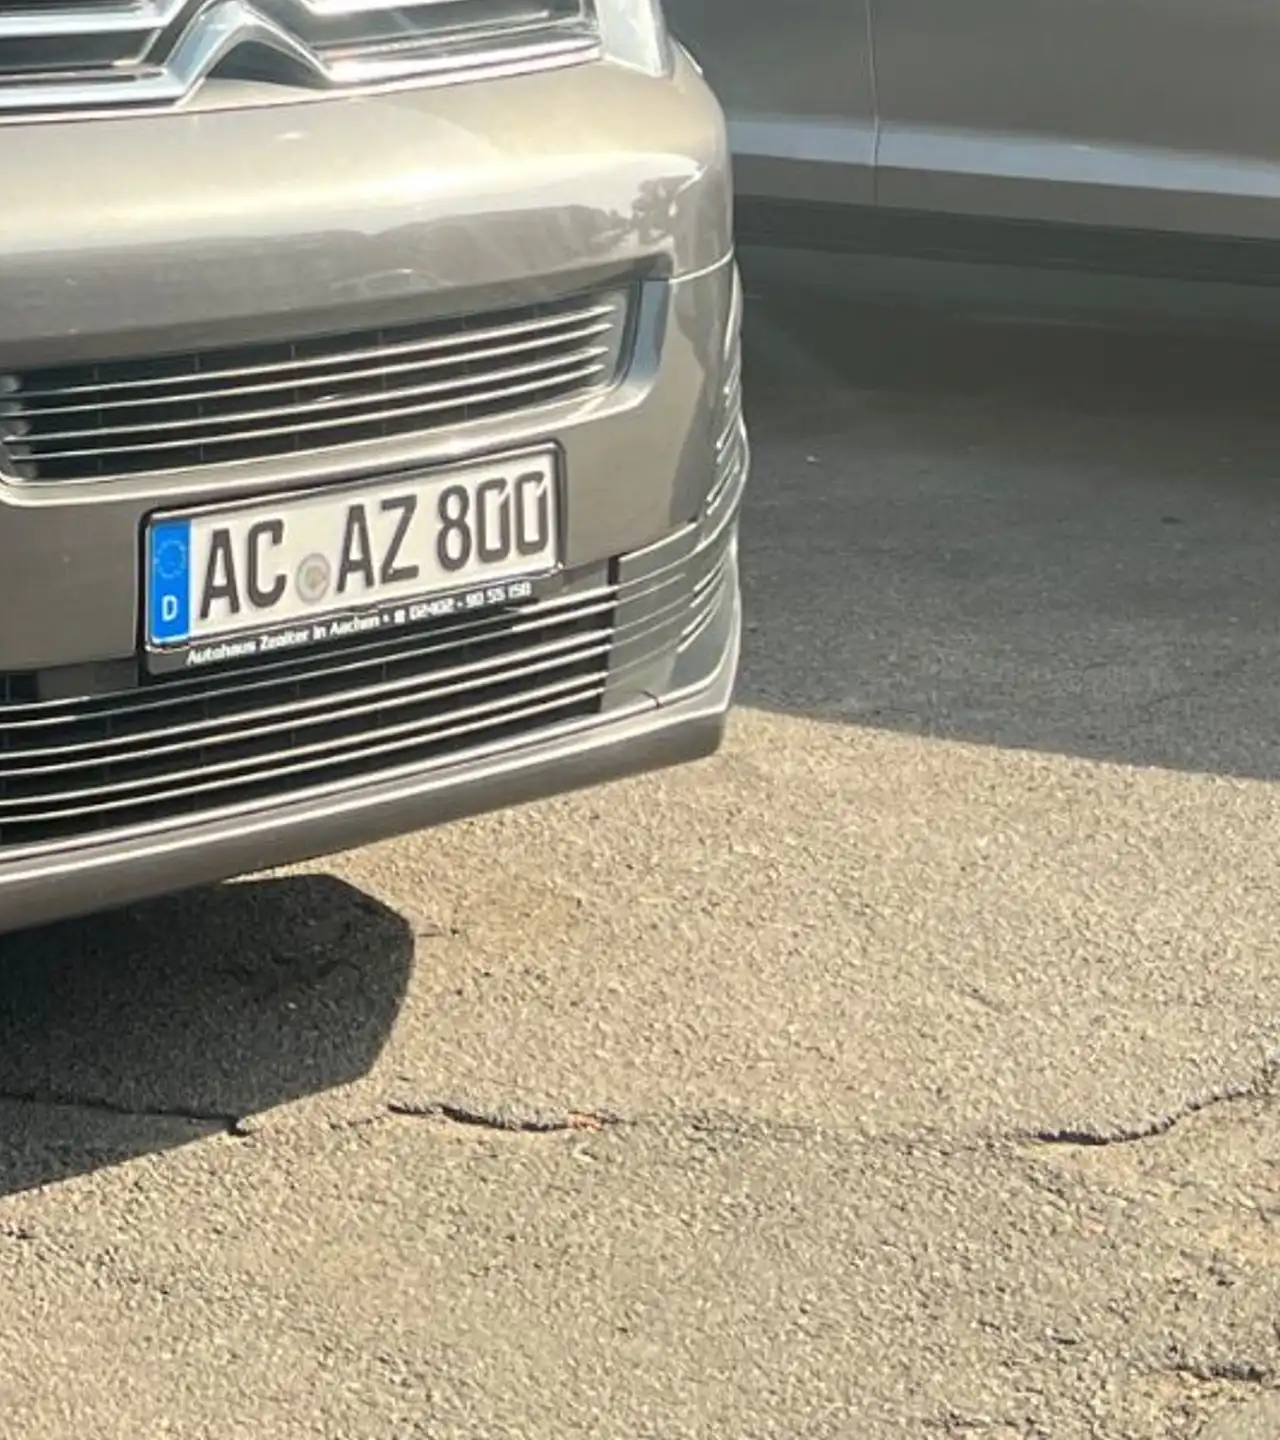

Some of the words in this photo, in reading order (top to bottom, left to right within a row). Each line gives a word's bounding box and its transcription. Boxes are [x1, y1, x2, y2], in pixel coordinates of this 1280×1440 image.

[199, 517, 287, 621] AC
[336, 493, 420, 594] AZ
[436, 470, 550, 573] 800
[161, 594, 179, 622] D
